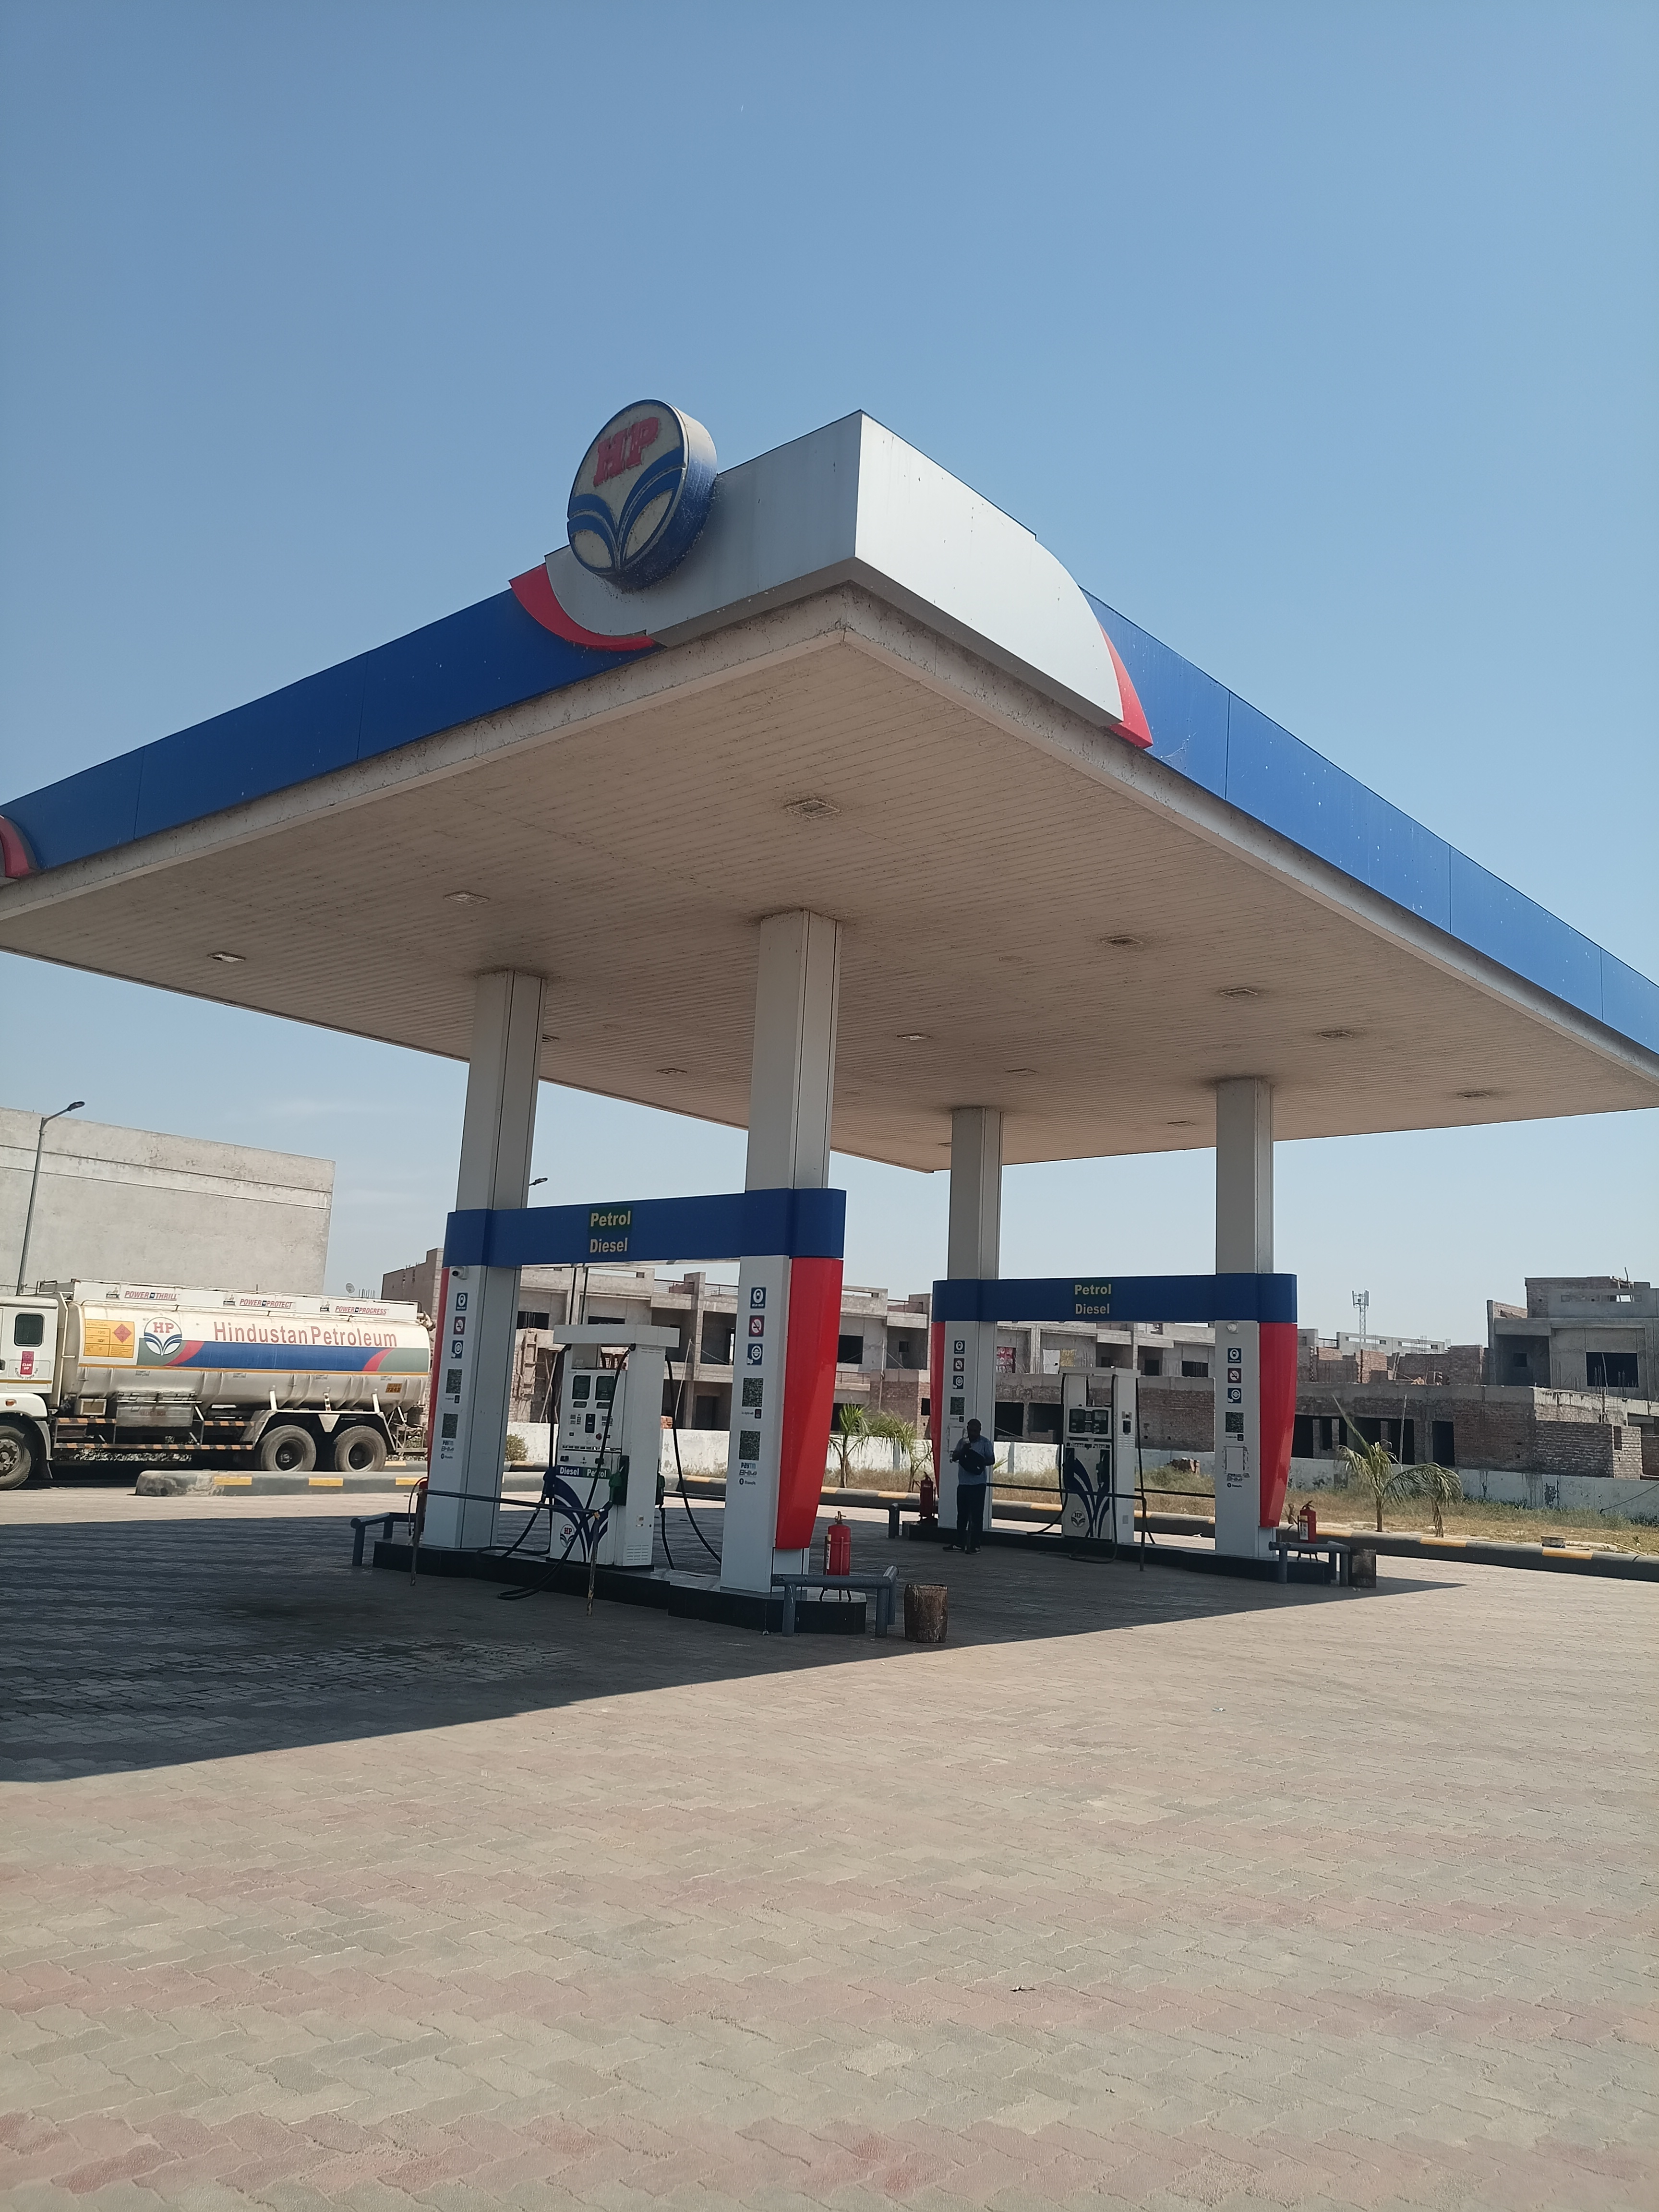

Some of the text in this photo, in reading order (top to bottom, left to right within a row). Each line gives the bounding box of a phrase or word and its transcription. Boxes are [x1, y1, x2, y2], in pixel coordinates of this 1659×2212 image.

[593, 417, 659, 487] HP
[590, 1210, 631, 1226] Petrol
[589, 1237, 628, 1253] Diesel
[125, 1290, 149, 1298] POWER
[1075, 1284, 1111, 1295] Petrol
[1075, 1303, 1110, 1314] Diesel
[153, 1322, 174, 1334] HP
[214, 1322, 397, 1347] Hindustan Petroleum
[560, 1467, 579, 1476] Diesel
